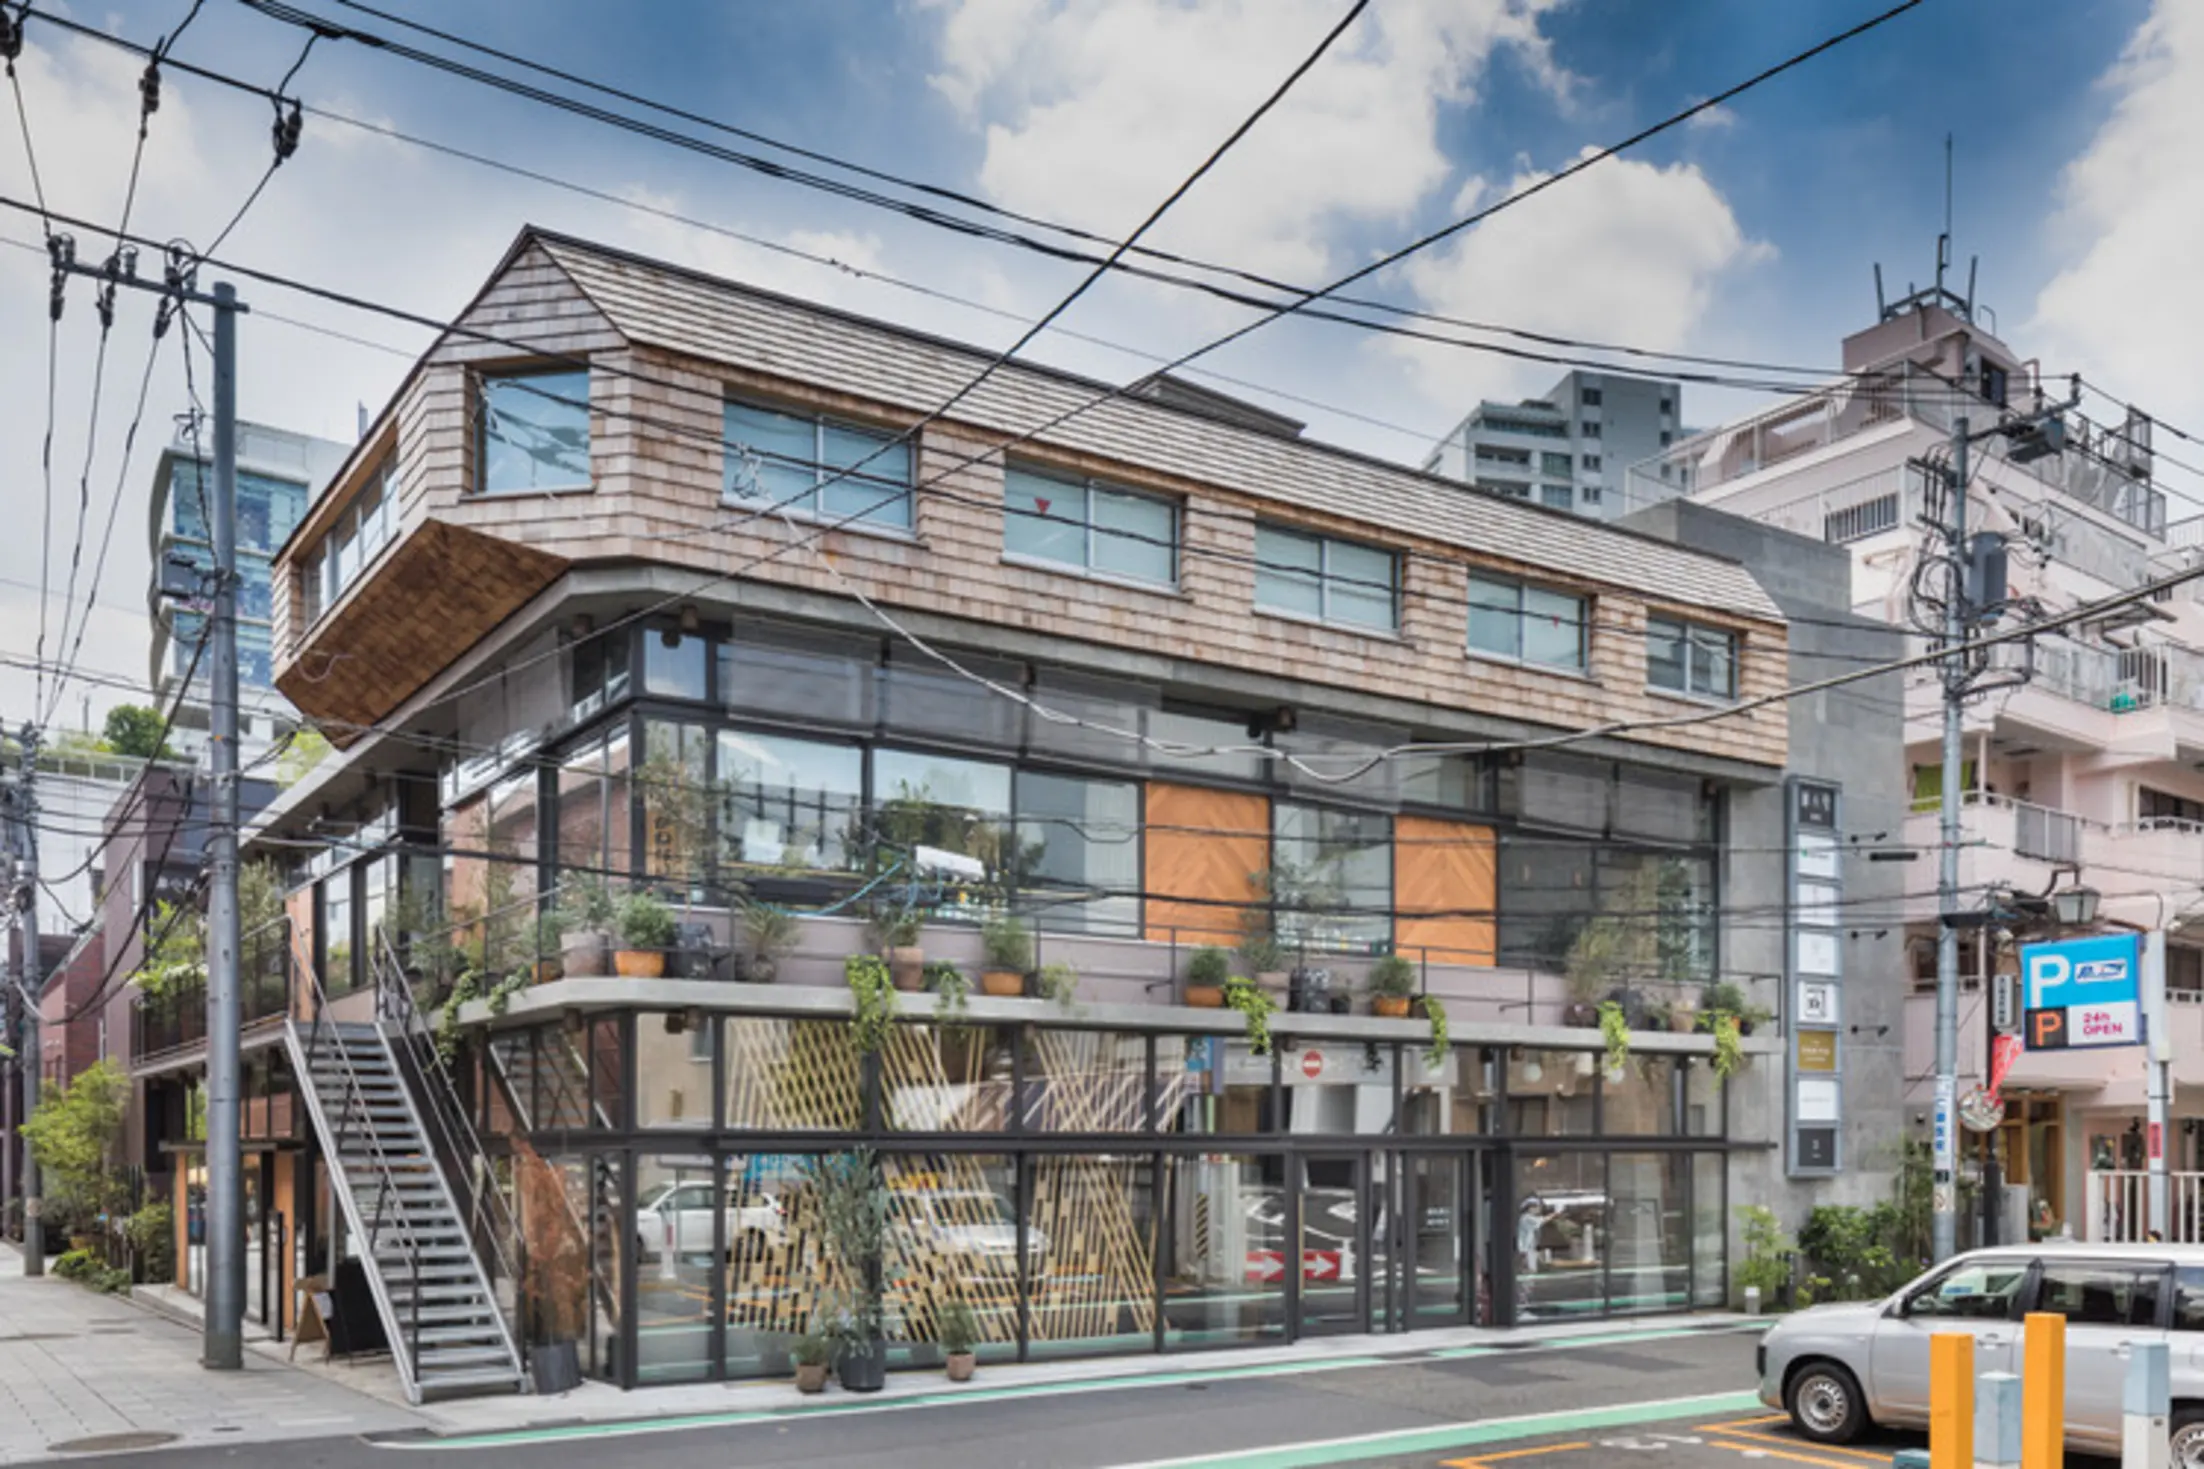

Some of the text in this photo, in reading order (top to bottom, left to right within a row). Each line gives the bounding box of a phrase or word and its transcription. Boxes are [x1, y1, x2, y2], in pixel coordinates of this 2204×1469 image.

[2030, 955, 2070, 1008] P
[2035, 1011, 2062, 1046] P
[2083, 1022, 2123, 1035] OPEN
